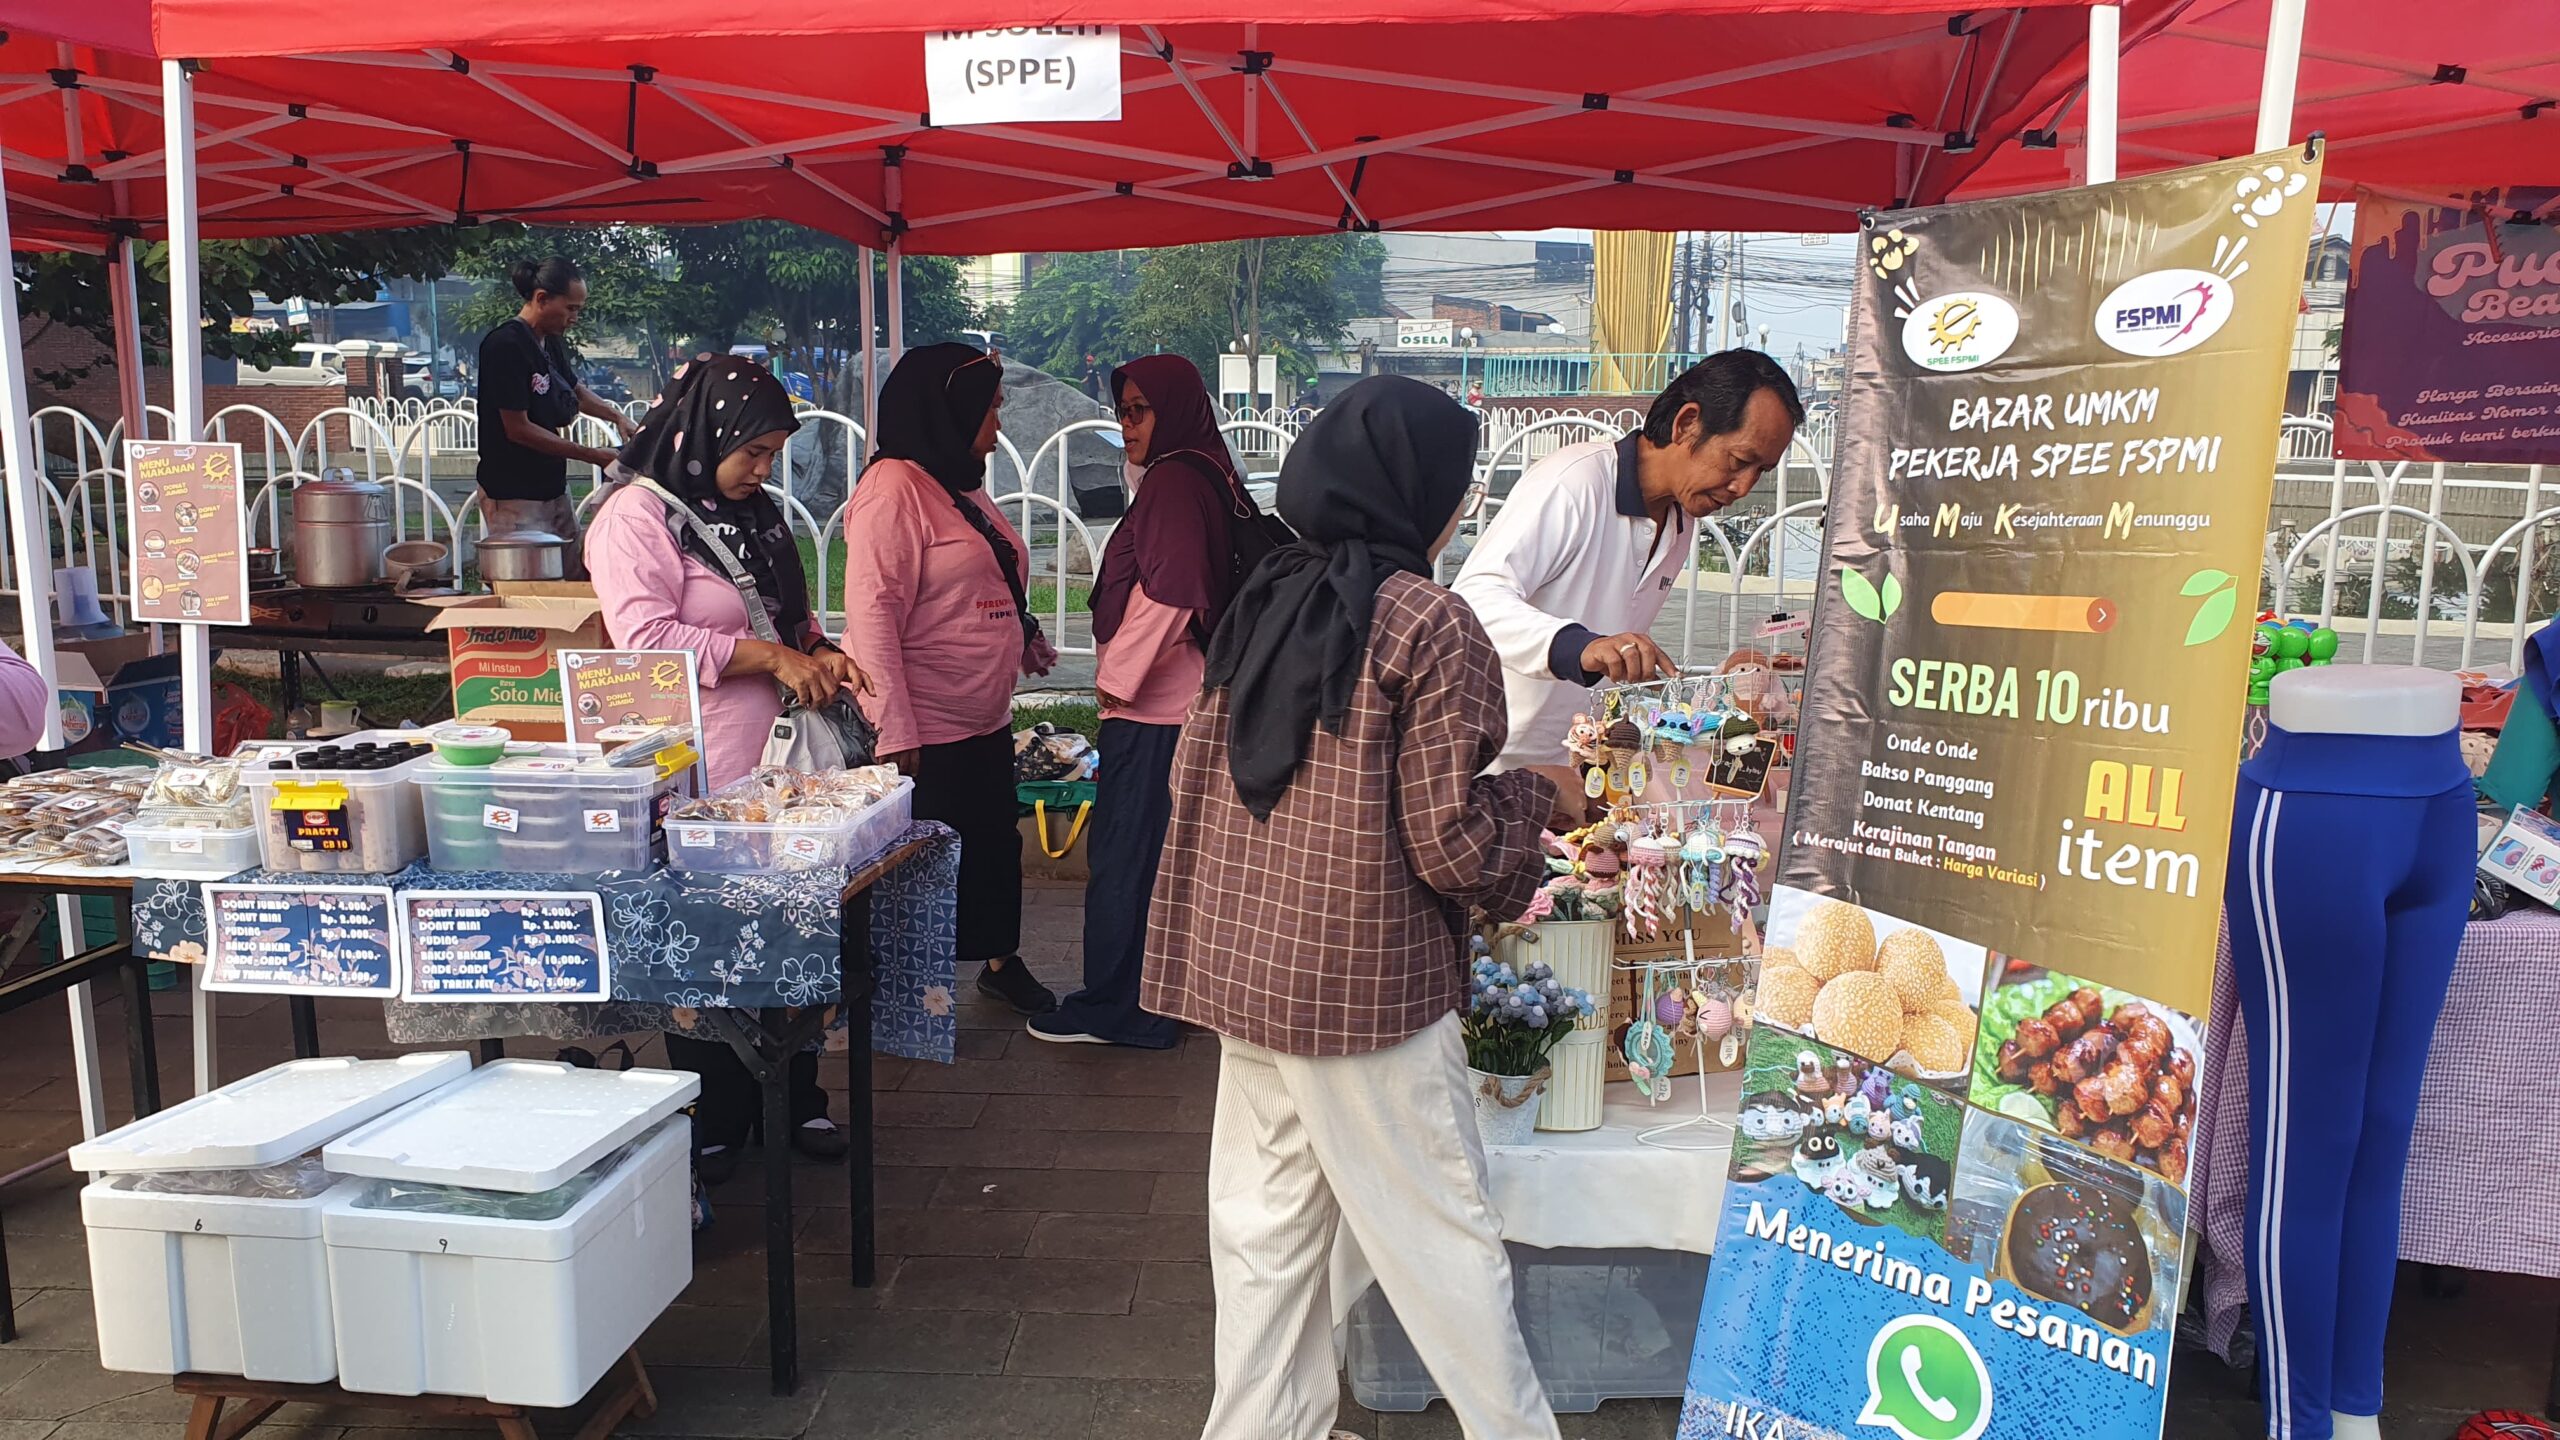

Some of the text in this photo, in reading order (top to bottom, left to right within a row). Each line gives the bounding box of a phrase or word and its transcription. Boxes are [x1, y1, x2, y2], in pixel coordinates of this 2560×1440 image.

[965, 56, 1075, 94] (SPPE)
[2115, 303, 2182, 329] FSPMI
[1401, 336, 1449, 344] OSELA
[1926, 354, 1979, 366] SPEE FSPMI
[2415, 388, 2480, 405] Harga
[1949, 387, 2160, 434] BAZAR UMKM
[2398, 411, 2477, 427] Kualitas
[2480, 405, 2548, 421] Nomor
[2385, 431, 2453, 449] Produk
[2459, 428, 2506, 443] kami
[139, 458, 170, 471] MENU
[1888, 436, 2223, 481] PEKERJA SPEE FSPMI
[140, 463, 195, 479] MAKANAN
[1873, 501, 2211, 540] Usaha Maju Kesejahteraan Menunggu
[478, 662, 521, 673] Mi Instan
[576, 667, 611, 681] MENU
[579, 671, 641, 690] MAKANAN
[490, 686, 563, 703] Soto Mie
[606, 692, 632, 702] DONAT
[1888, 657, 2171, 734] SERBA 10 ribu
[608, 698, 635, 707] JUMBO
[1886, 733, 1978, 761] Onde Onde
[1861, 760, 1994, 799] Bakso Panggang
[2083, 759, 2188, 833] ALL
[1863, 790, 1985, 829] Donat Kentang
[297, 827, 340, 836] PRACTY
[1852, 820, 1997, 861] Kerajinan Tangan
[1803, 831, 1864, 854] Merajut
[1865, 842, 1891, 860] dan
[1894, 847, 1933, 868] Buket
[1944, 857, 1984, 880] Harga
[1987, 865, 2038, 888] Variasi
[2057, 818, 2200, 898] item
[221, 900, 291, 911] DONUT JUMBO
[319, 901, 336, 912] Rp.
[223, 912, 282, 923] DONUT MINI
[417, 907, 490, 918] DONUT JUMBO
[521, 907, 539, 918] Rp.
[320, 914, 337, 925] Rp.
[419, 920, 481, 931] DONUT MINI
[224, 926, 261, 937] PUDING
[523, 920, 541, 932] Rp.
[321, 929, 338, 940] Rp.
[419, 935, 459, 945] PUDING
[524, 934, 541, 946] Rp.
[1662, 929, 1702, 942] YOU
[225, 941, 291, 952] BAKSO BAKAR
[320, 949, 337, 960] Rp.
[420, 950, 491, 961] BAKSO BAKAR
[523, 955, 541, 967] Rp.
[321, 971, 338, 981] Rp.
[422, 979, 440, 989] TEH
[442, 979, 474, 989] TARIK
[525, 978, 543, 989] Rp.
[194, 1219, 203, 1231] 6
[439, 1238, 448, 1254] 9
[1743, 1201, 2157, 1388] Menerima Pesanan
[1723, 1400, 1786, 1440] IKA
